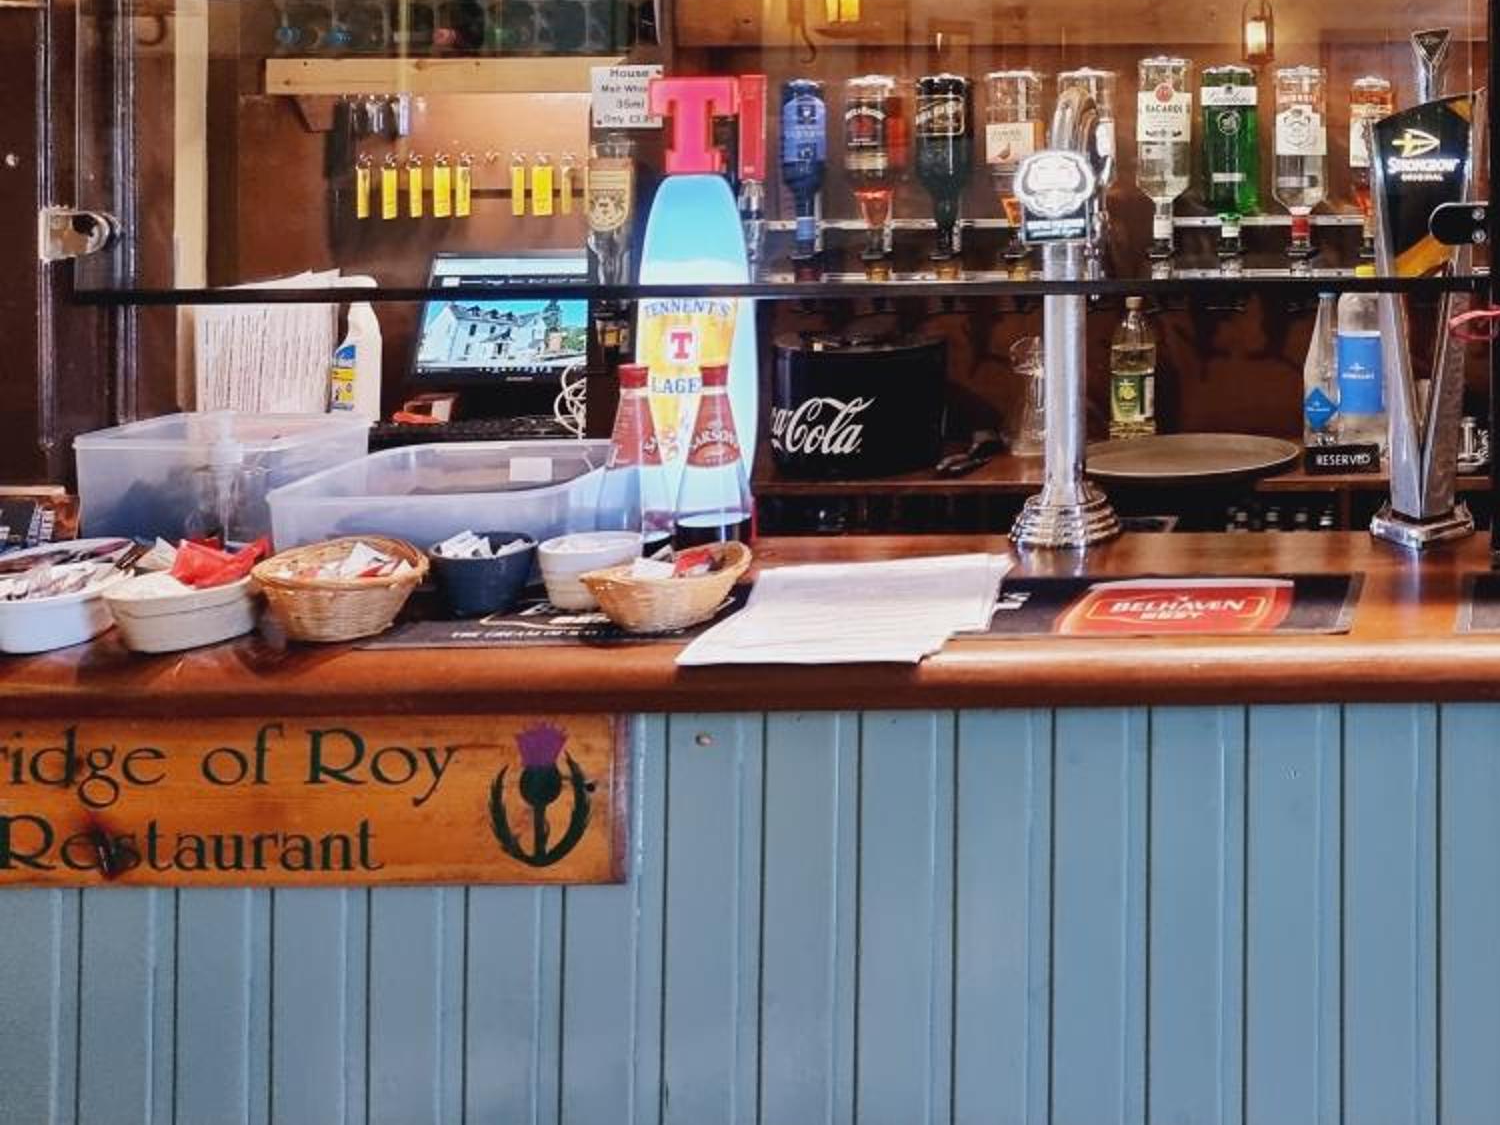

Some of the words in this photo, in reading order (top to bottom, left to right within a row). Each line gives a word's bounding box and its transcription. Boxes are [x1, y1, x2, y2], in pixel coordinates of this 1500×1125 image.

[609, 68, 650, 78] House
[1144, 103, 1183, 114] BACARDI
[1387, 156, 1461, 175] STRONGBOW
[643, 298, 731, 317] TENNENT'S
[651, 376, 701, 394] LAGE
[1110, 597, 1248, 615] BELHAVEN
[200, 722, 285, 787] of
[307, 727, 459, 808] Roy
[0, 813, 385, 874] Restaurant
